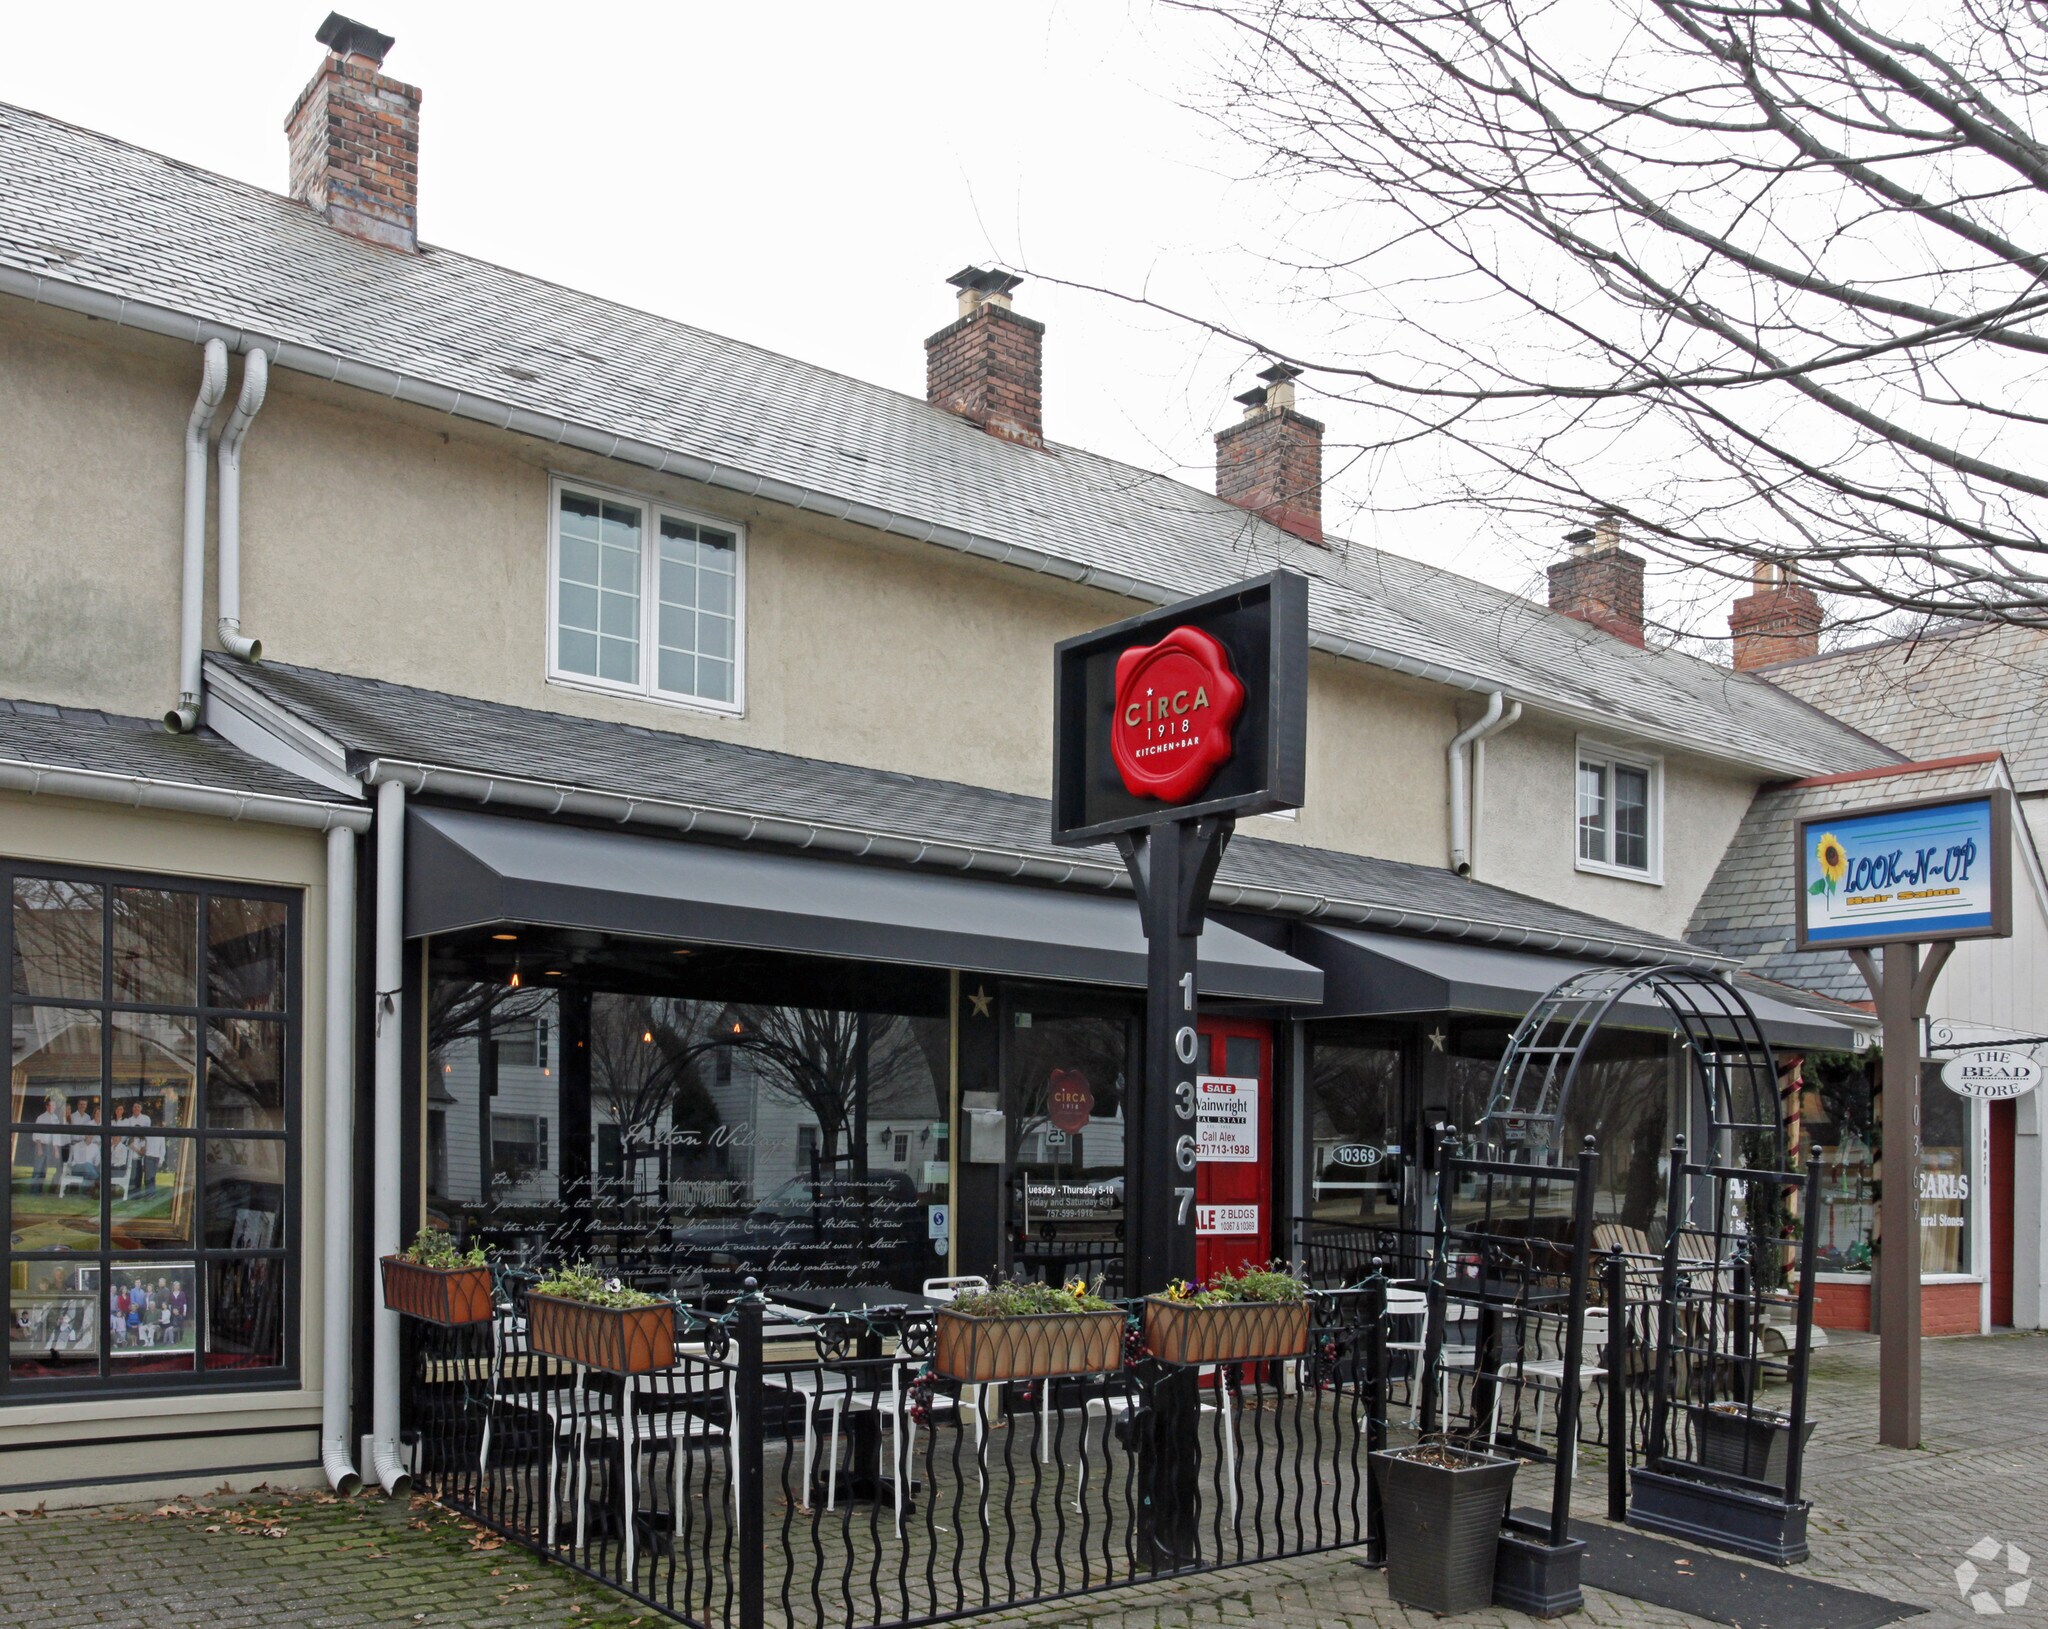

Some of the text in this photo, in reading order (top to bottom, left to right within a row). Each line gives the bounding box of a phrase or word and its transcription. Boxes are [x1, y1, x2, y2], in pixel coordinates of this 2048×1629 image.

[1125, 686, 1210, 727] CIRCA
[1147, 719, 1190, 741] 1918
[1846, 887, 1960, 906] Hair Salon
[1973, 1052, 2011, 1064] THE
[1962, 1066, 2030, 1078] BEAD
[1207, 1084, 1232, 1093] SALE
[1961, 1083, 2021, 1096] STORE
[1054, 1088, 1086, 1103] CIRCA
[1174, 972, 1198, 1226] 10367
[1202, 1131, 1236, 1142] Call Alex
[1212, 1145, 1250, 1155] 713-1938
[1339, 1149, 1376, 1162] 10369
[1062, 1185, 1097, 1196] Thursday
[1098, 1185, 1114, 1195] 5-10
[1050, 1197, 1063, 1206] and
[1065, 1197, 1097, 1208] Saturday
[1099, 1197, 1114, 1206] 5-11
[1046, 1209, 1094, 1218] 757-599-1918
[1220, 1209, 1255, 1219] 2 BLDGS
[1939, 1213, 1964, 1227] Stones
